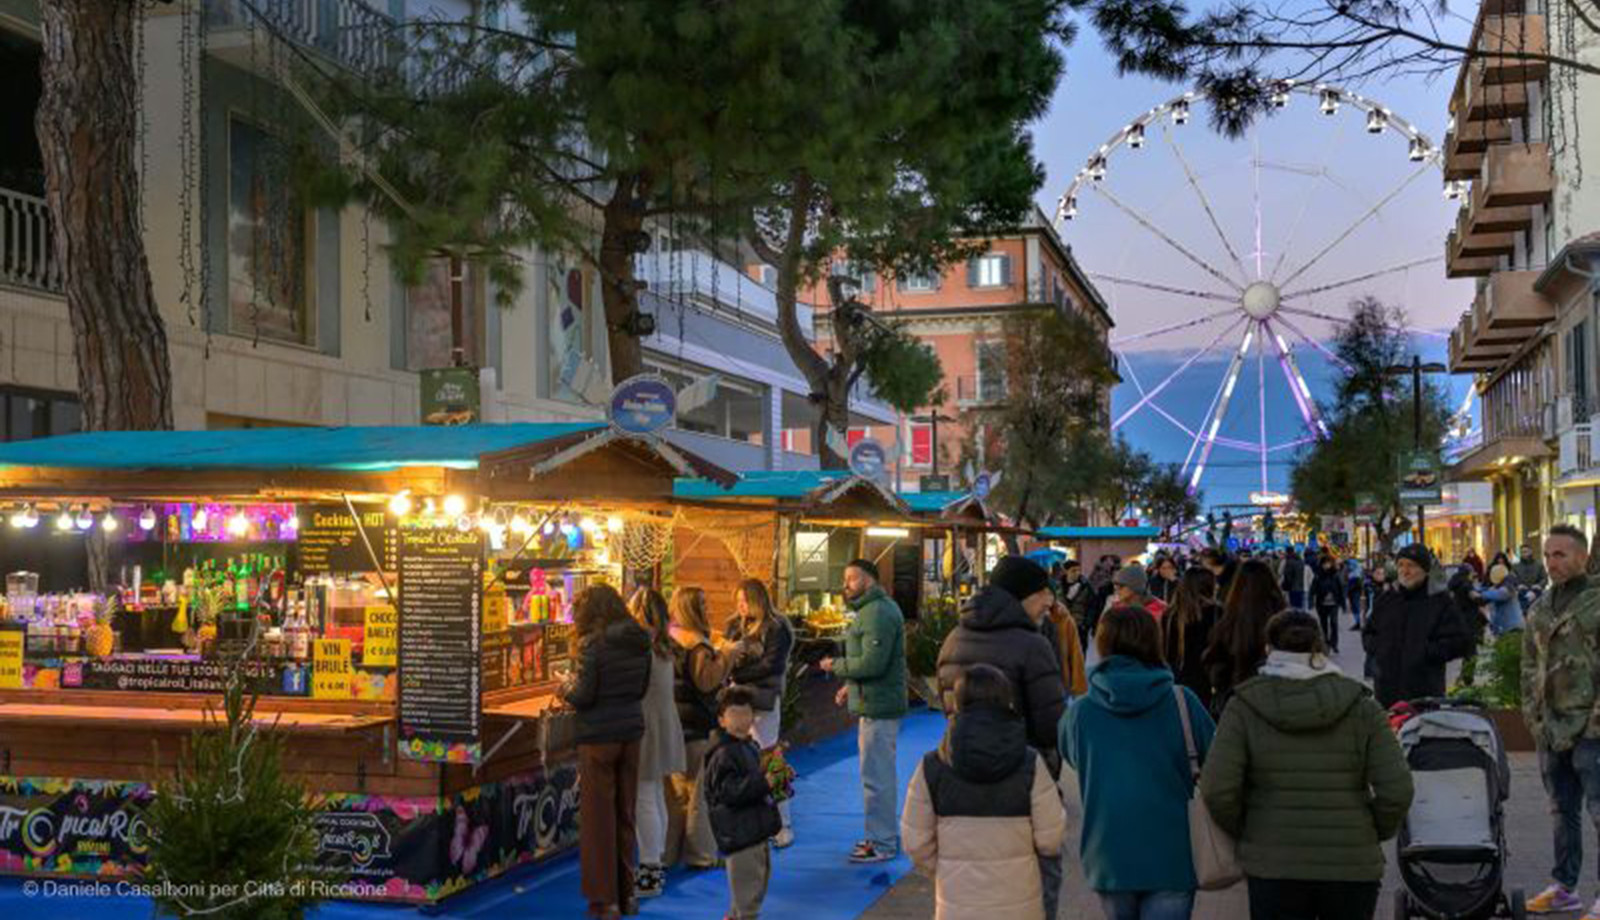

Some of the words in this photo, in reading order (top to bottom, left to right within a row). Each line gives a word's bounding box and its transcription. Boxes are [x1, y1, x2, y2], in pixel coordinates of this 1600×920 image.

[321, 642, 341, 655] VIN
[137, 664, 168, 674] NELLE
[171, 665, 190, 675] TUE
